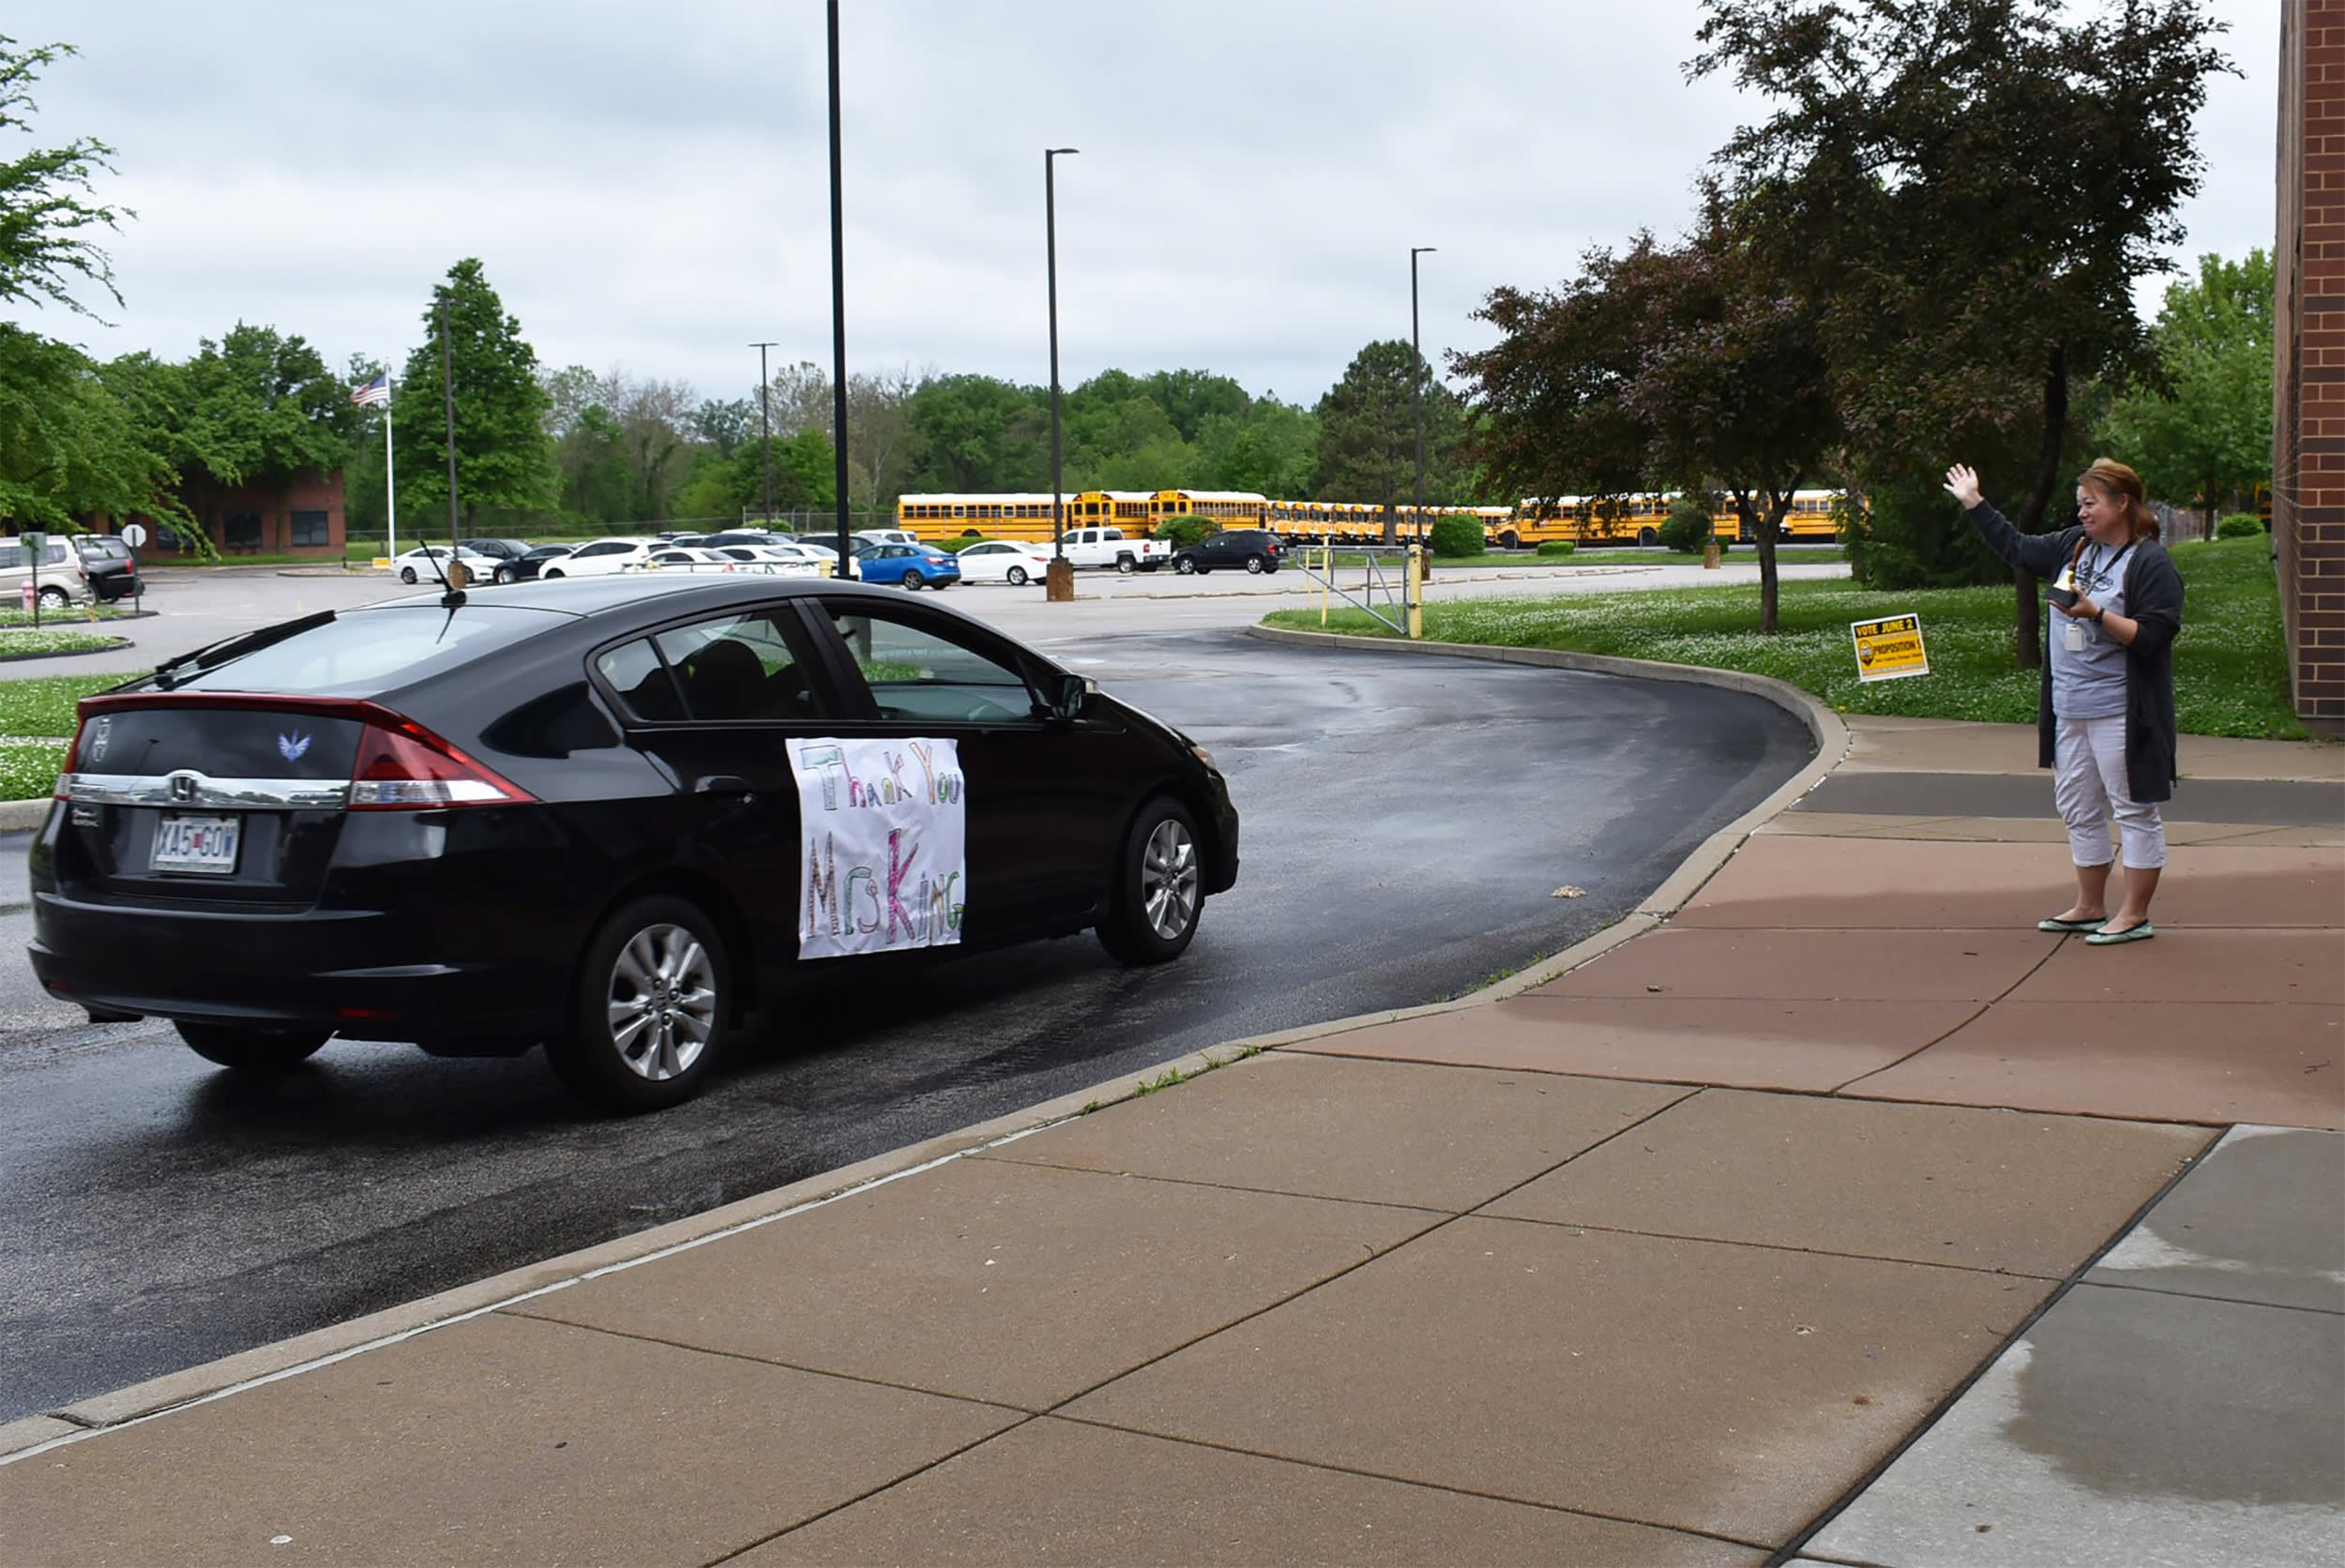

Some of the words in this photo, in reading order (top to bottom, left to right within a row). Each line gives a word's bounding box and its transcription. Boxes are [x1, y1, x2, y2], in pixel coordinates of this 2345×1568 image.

[1856, 625, 1878, 636] VOTE
[1882, 621, 1905, 632] JUNE
[1906, 619, 1914, 629] 2
[806, 831, 881, 939] Mrs
